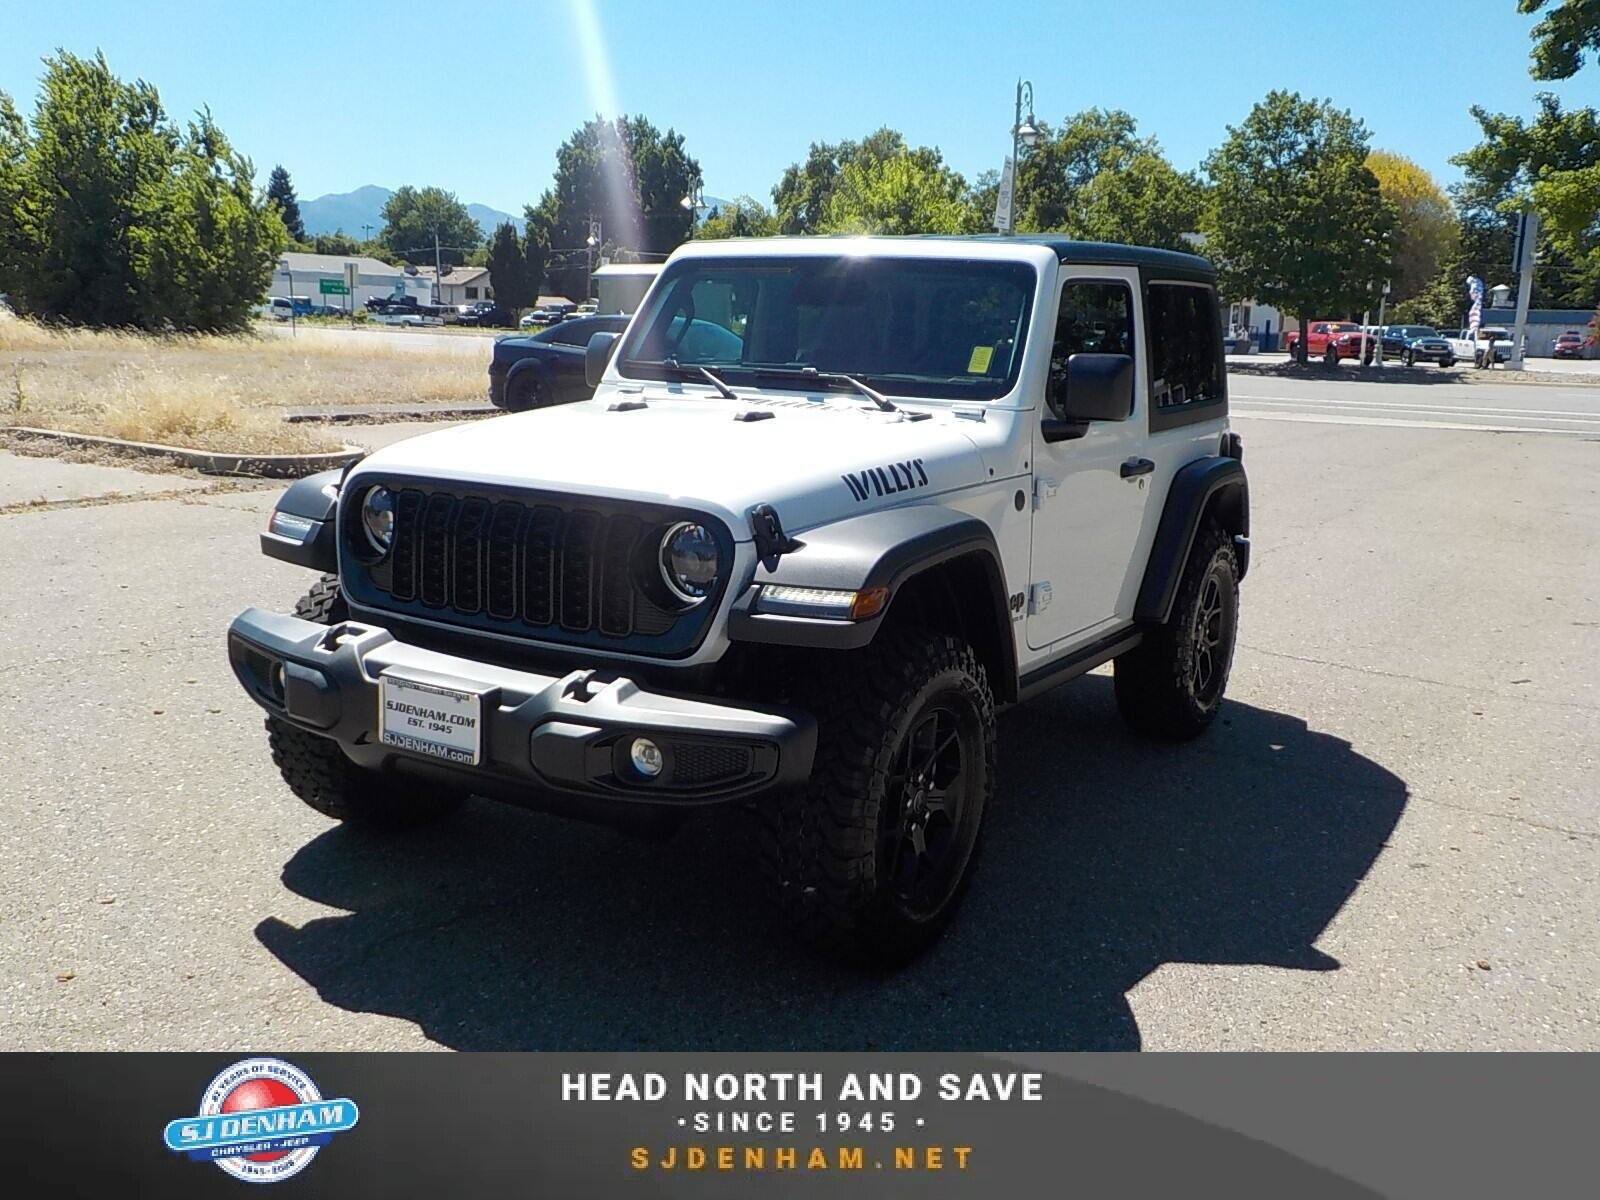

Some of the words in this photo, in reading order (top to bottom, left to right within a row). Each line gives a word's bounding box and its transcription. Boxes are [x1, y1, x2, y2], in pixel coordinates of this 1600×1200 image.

[840, 458, 929, 502] WILLYS
[386, 700, 476, 728] SJDENHAM.COM
[407, 717, 425, 728] EST.
[428, 722, 453, 734] 1945
[383, 732, 474, 764] SJDENHAM.com
